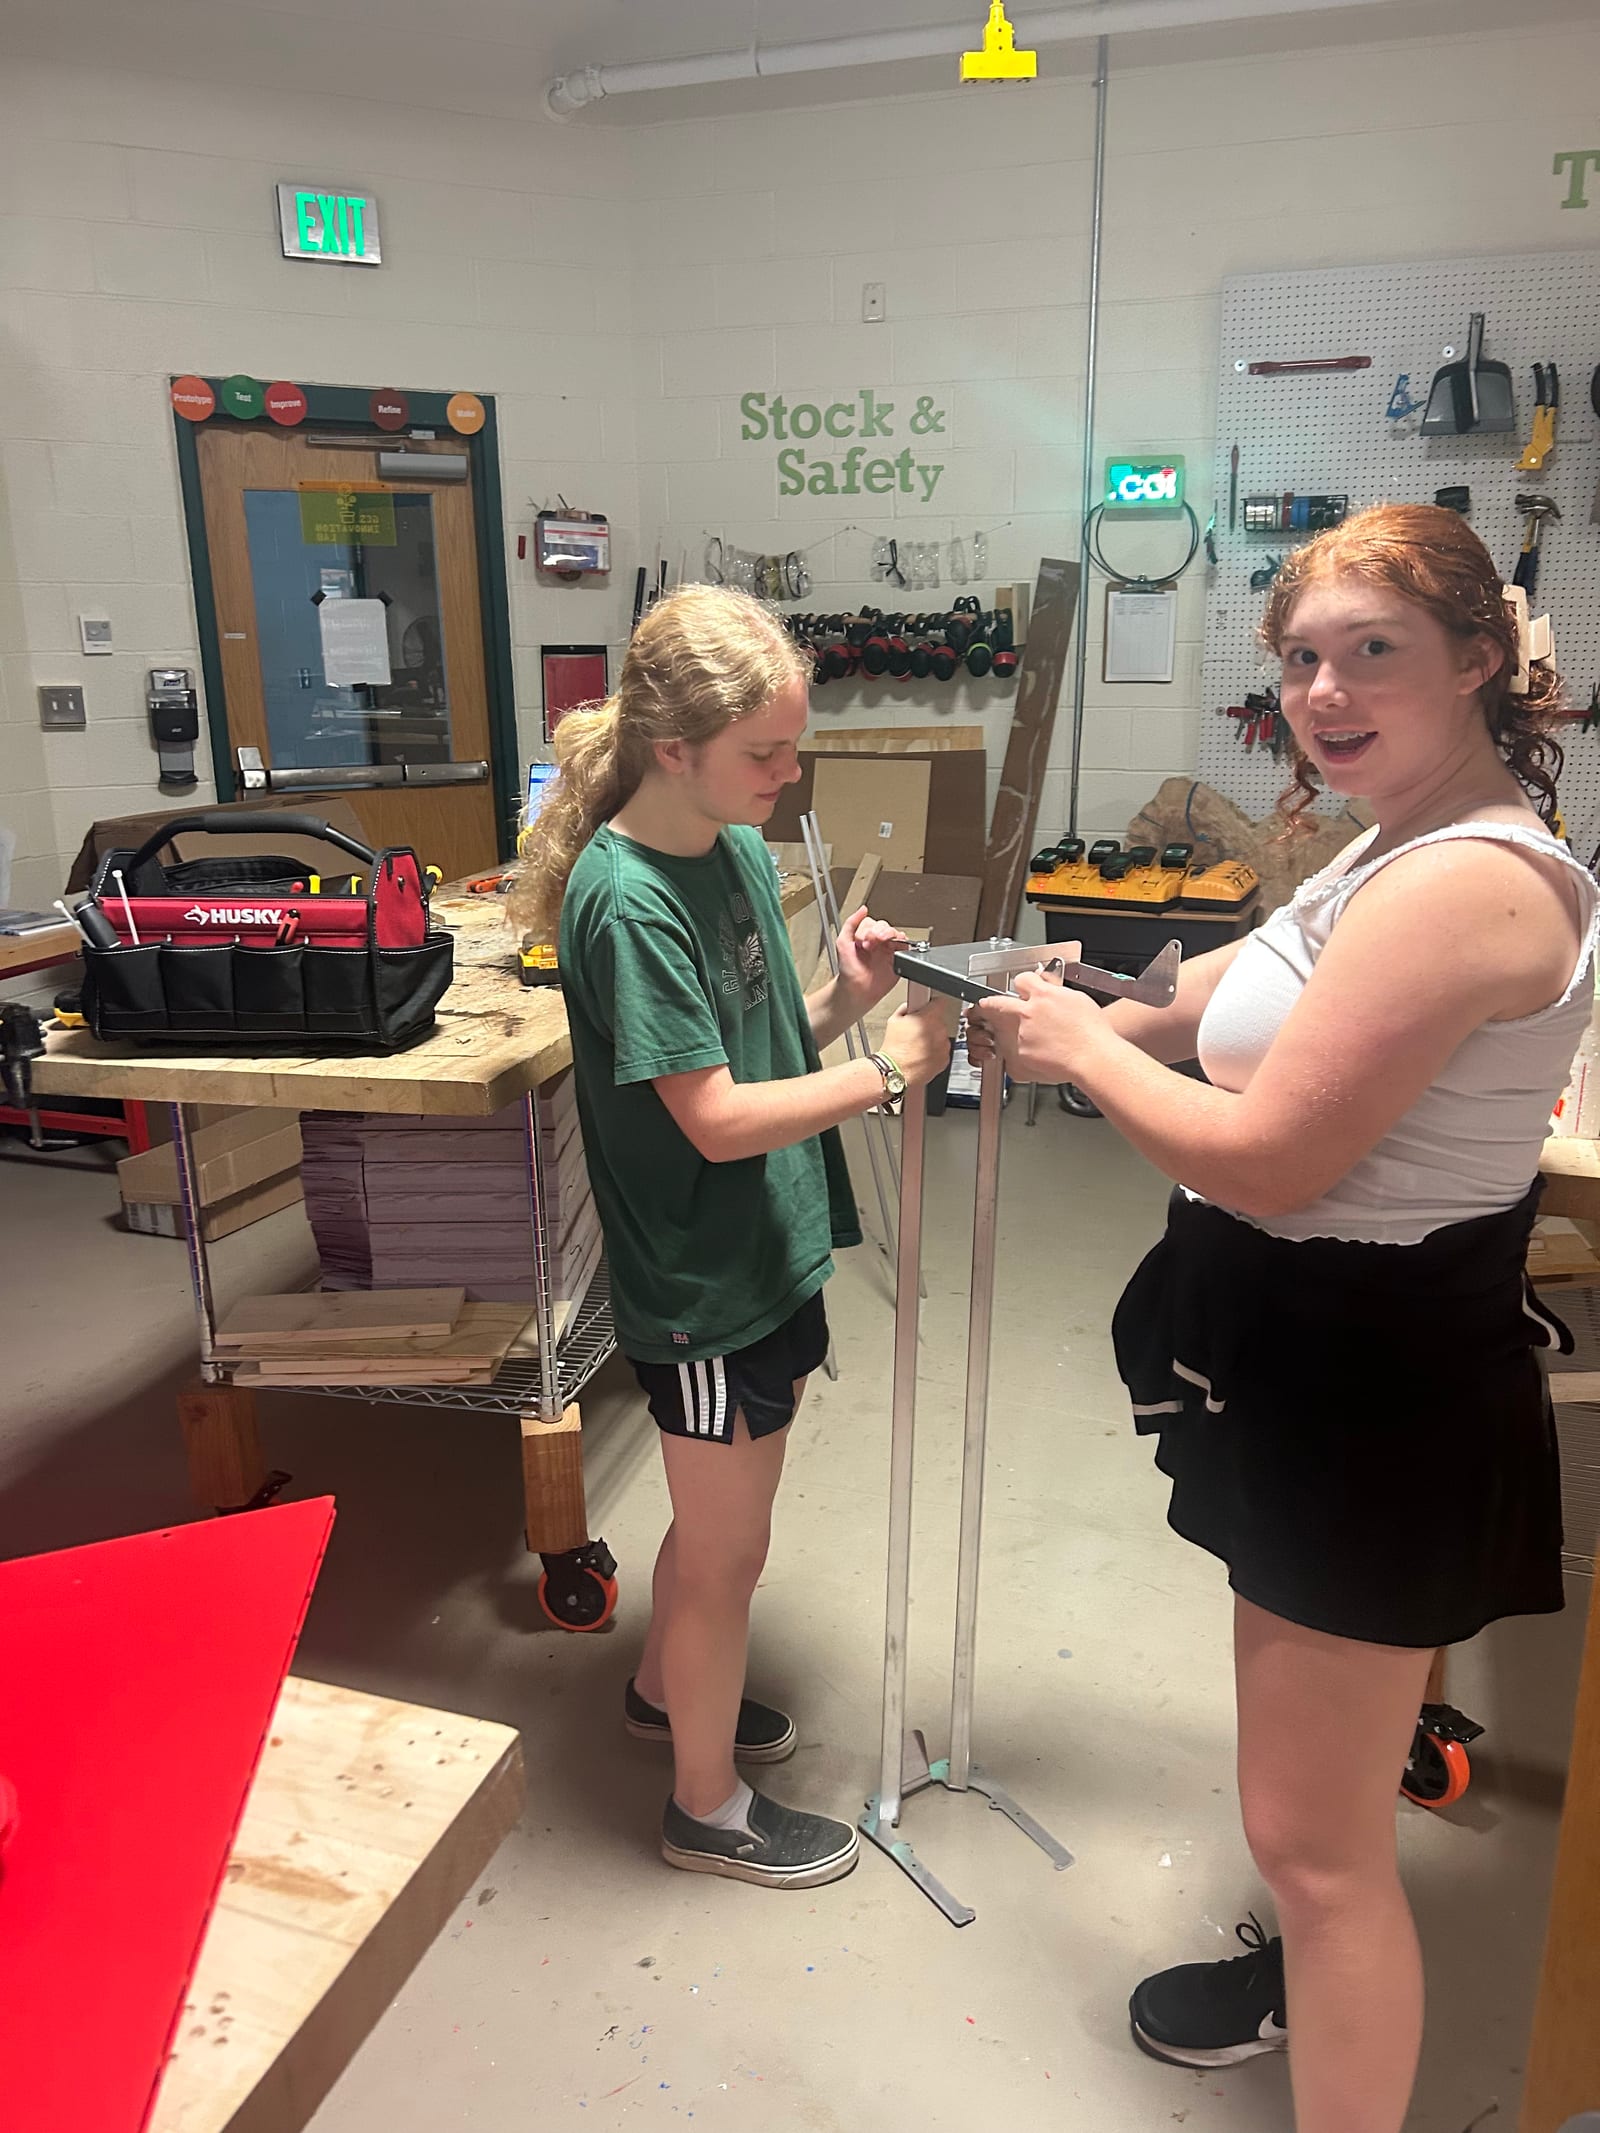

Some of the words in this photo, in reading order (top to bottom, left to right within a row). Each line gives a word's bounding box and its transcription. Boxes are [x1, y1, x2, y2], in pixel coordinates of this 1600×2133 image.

[295, 191, 366, 257] EXIT
[173, 393, 213, 405] Prototype
[234, 391, 252, 403] Test
[270, 399, 302, 410] Improve
[377, 404, 402, 415] Refine
[740, 389, 895, 440] Stock
[909, 395, 946, 435] &
[777, 446, 945, 502] Safety
[210, 908, 283, 925] HUSKY
